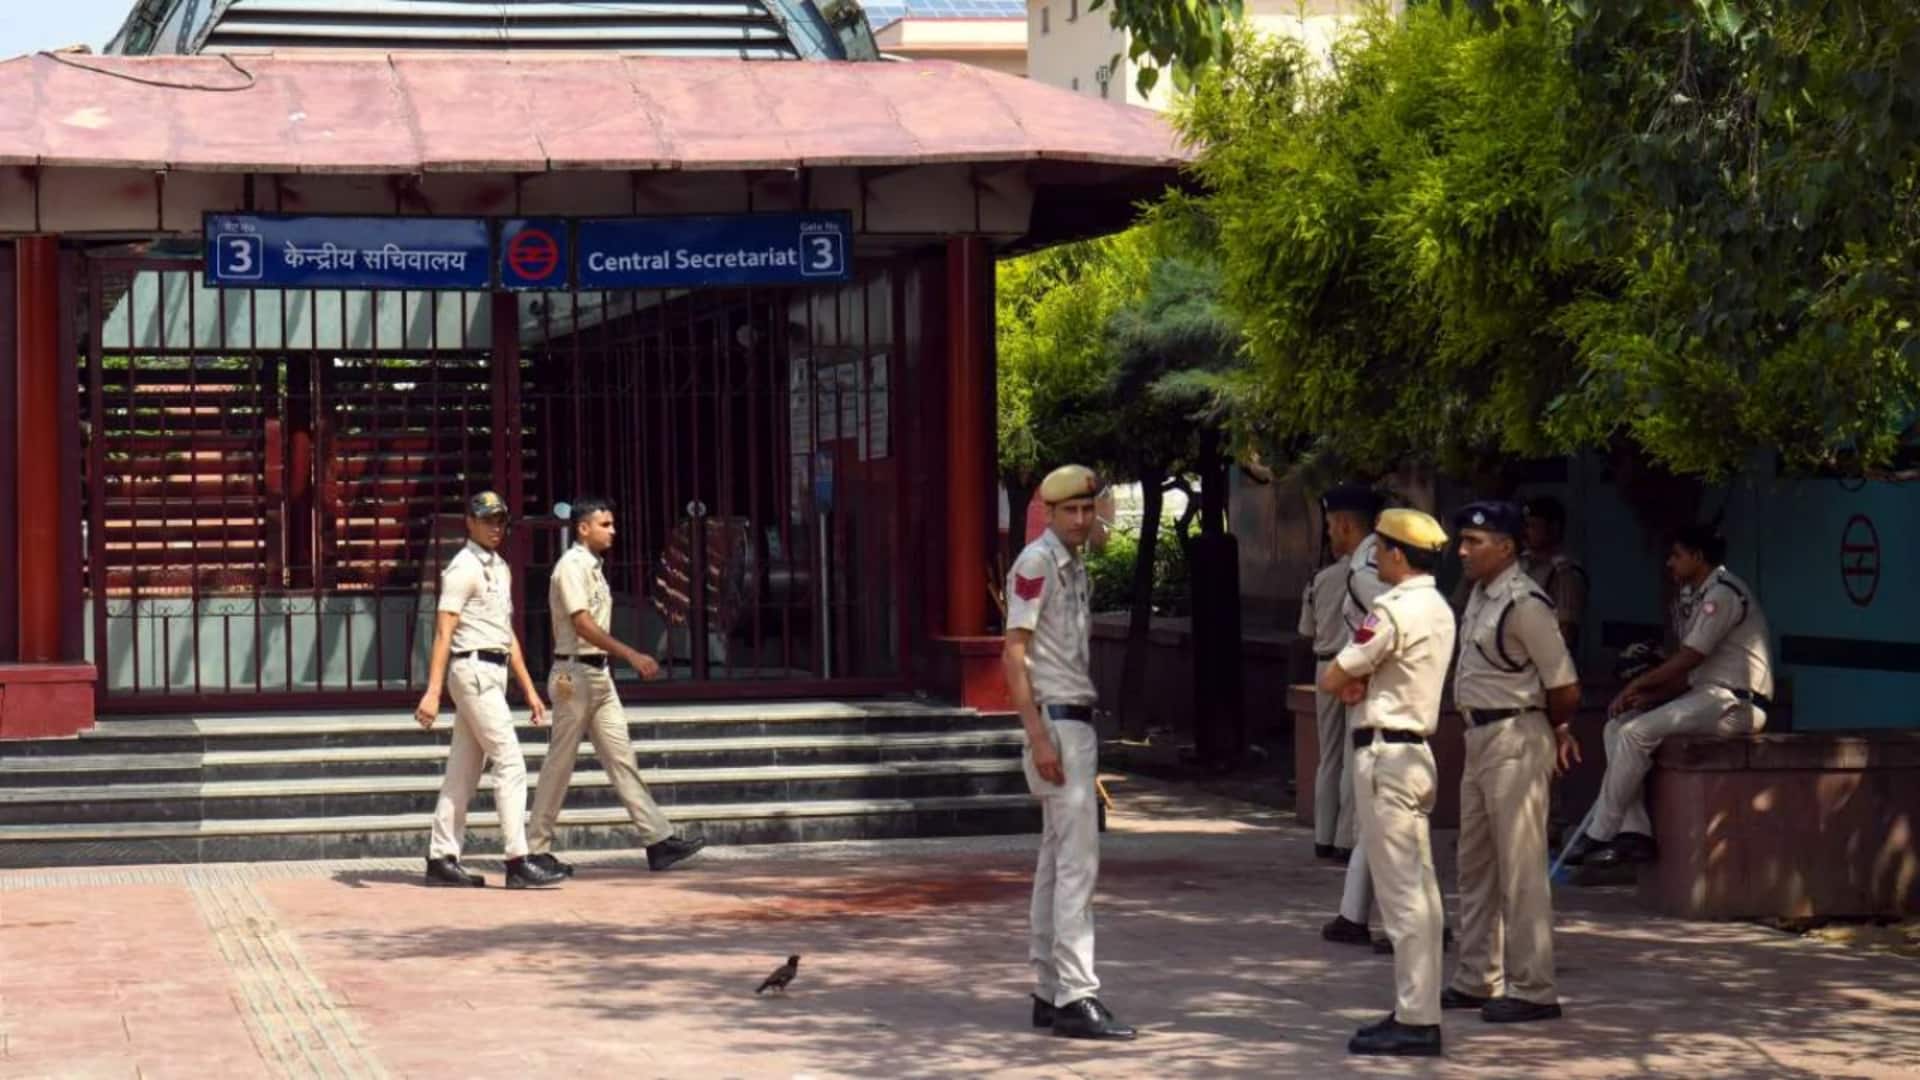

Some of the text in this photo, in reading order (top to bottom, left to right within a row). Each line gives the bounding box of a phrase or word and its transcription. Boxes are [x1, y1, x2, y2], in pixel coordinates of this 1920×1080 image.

[229, 239, 253, 273] 3
[284, 240, 468, 271] केन्द्रीय सचिवालय
[588, 247, 798, 272] Central Secretariat
[811, 237, 834, 270] 3
